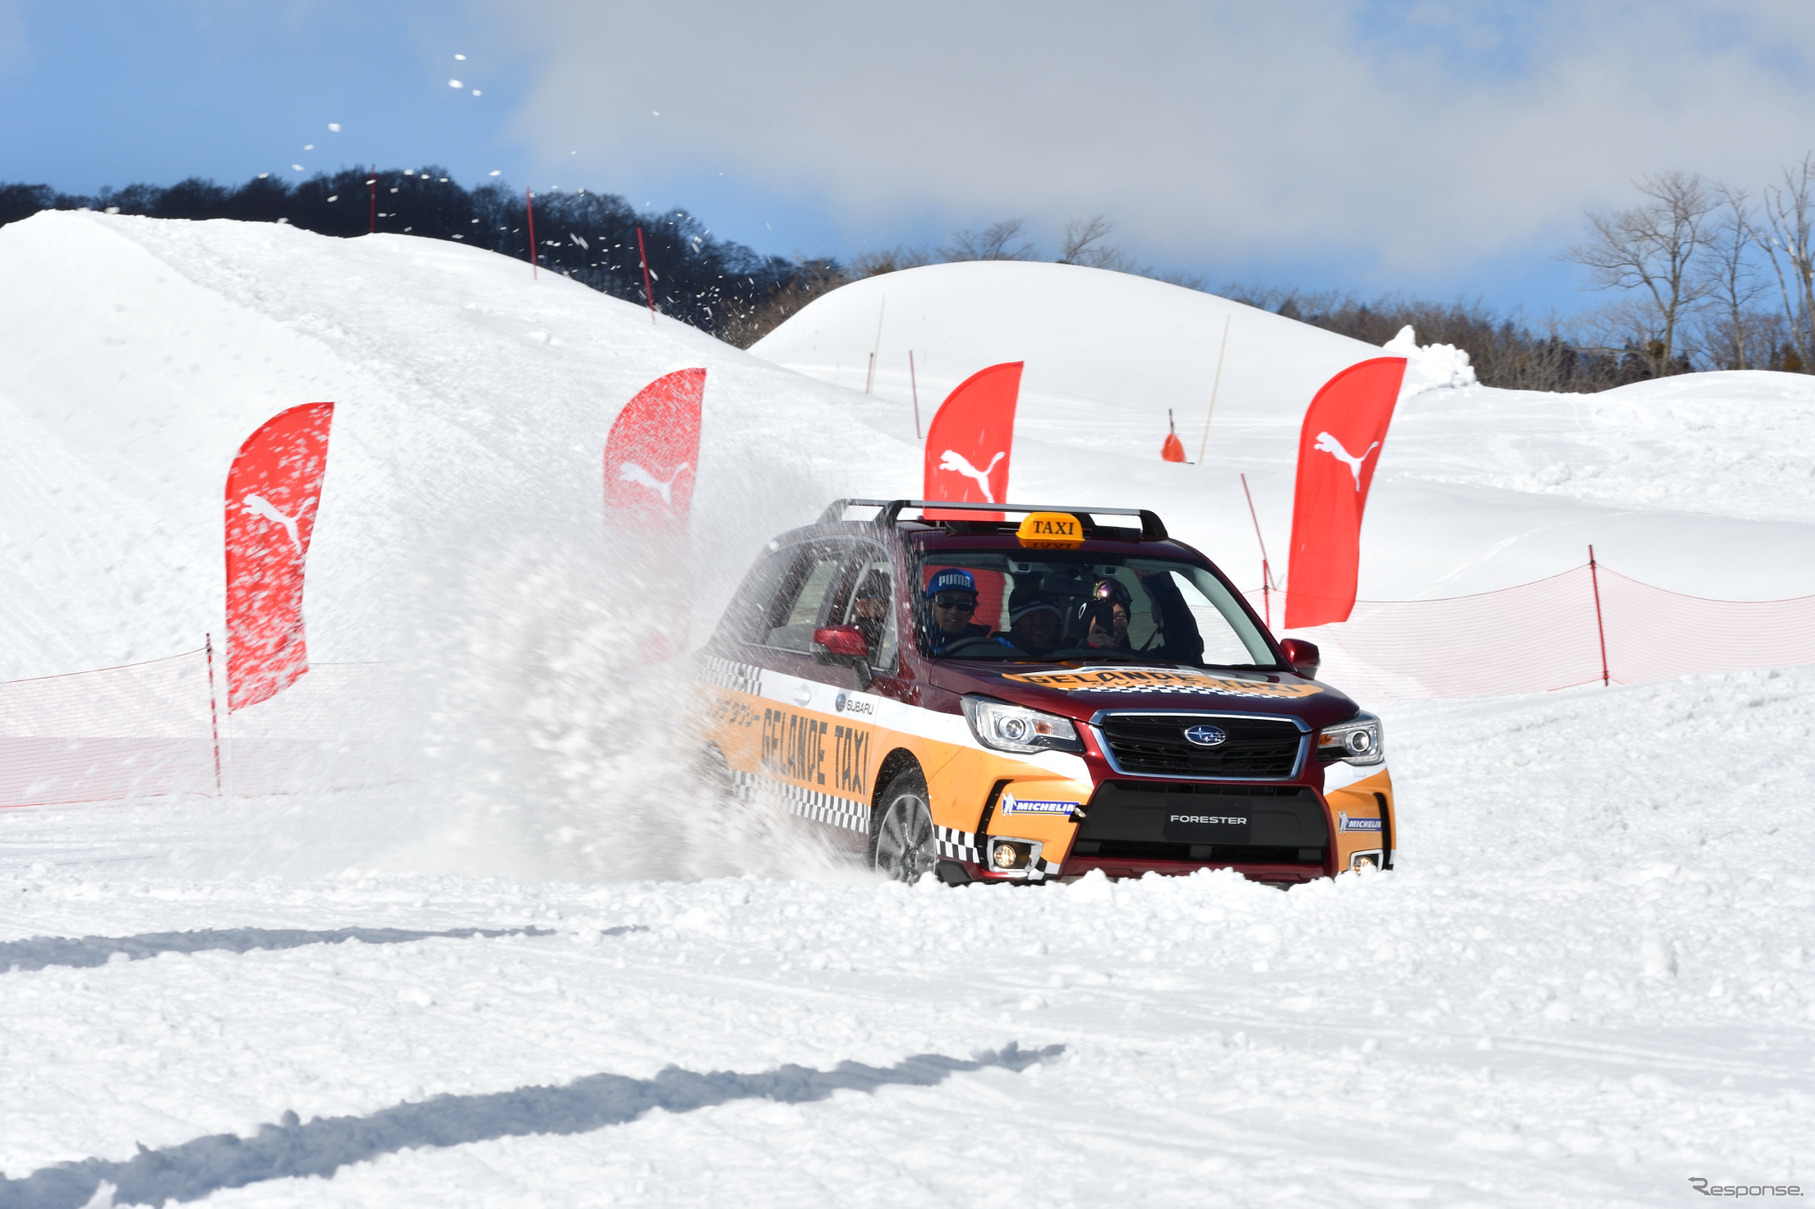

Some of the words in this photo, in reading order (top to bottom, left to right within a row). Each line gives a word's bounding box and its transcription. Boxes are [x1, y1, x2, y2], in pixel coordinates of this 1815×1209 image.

[1033, 520, 1075, 536] TAXI
[938, 573, 971, 588] PUMA
[1020, 671, 1201, 685] GELANDE
[1217, 679, 1302, 693] TAXI
[846, 699, 875, 716] SUBARU
[761, 708, 828, 786] GELANDE
[834, 725, 870, 796] TAXI
[1016, 802, 1076, 812] MICHELIN
[1170, 814, 1248, 825] FORESTER
[1347, 820, 1382, 828] MICHELIN
